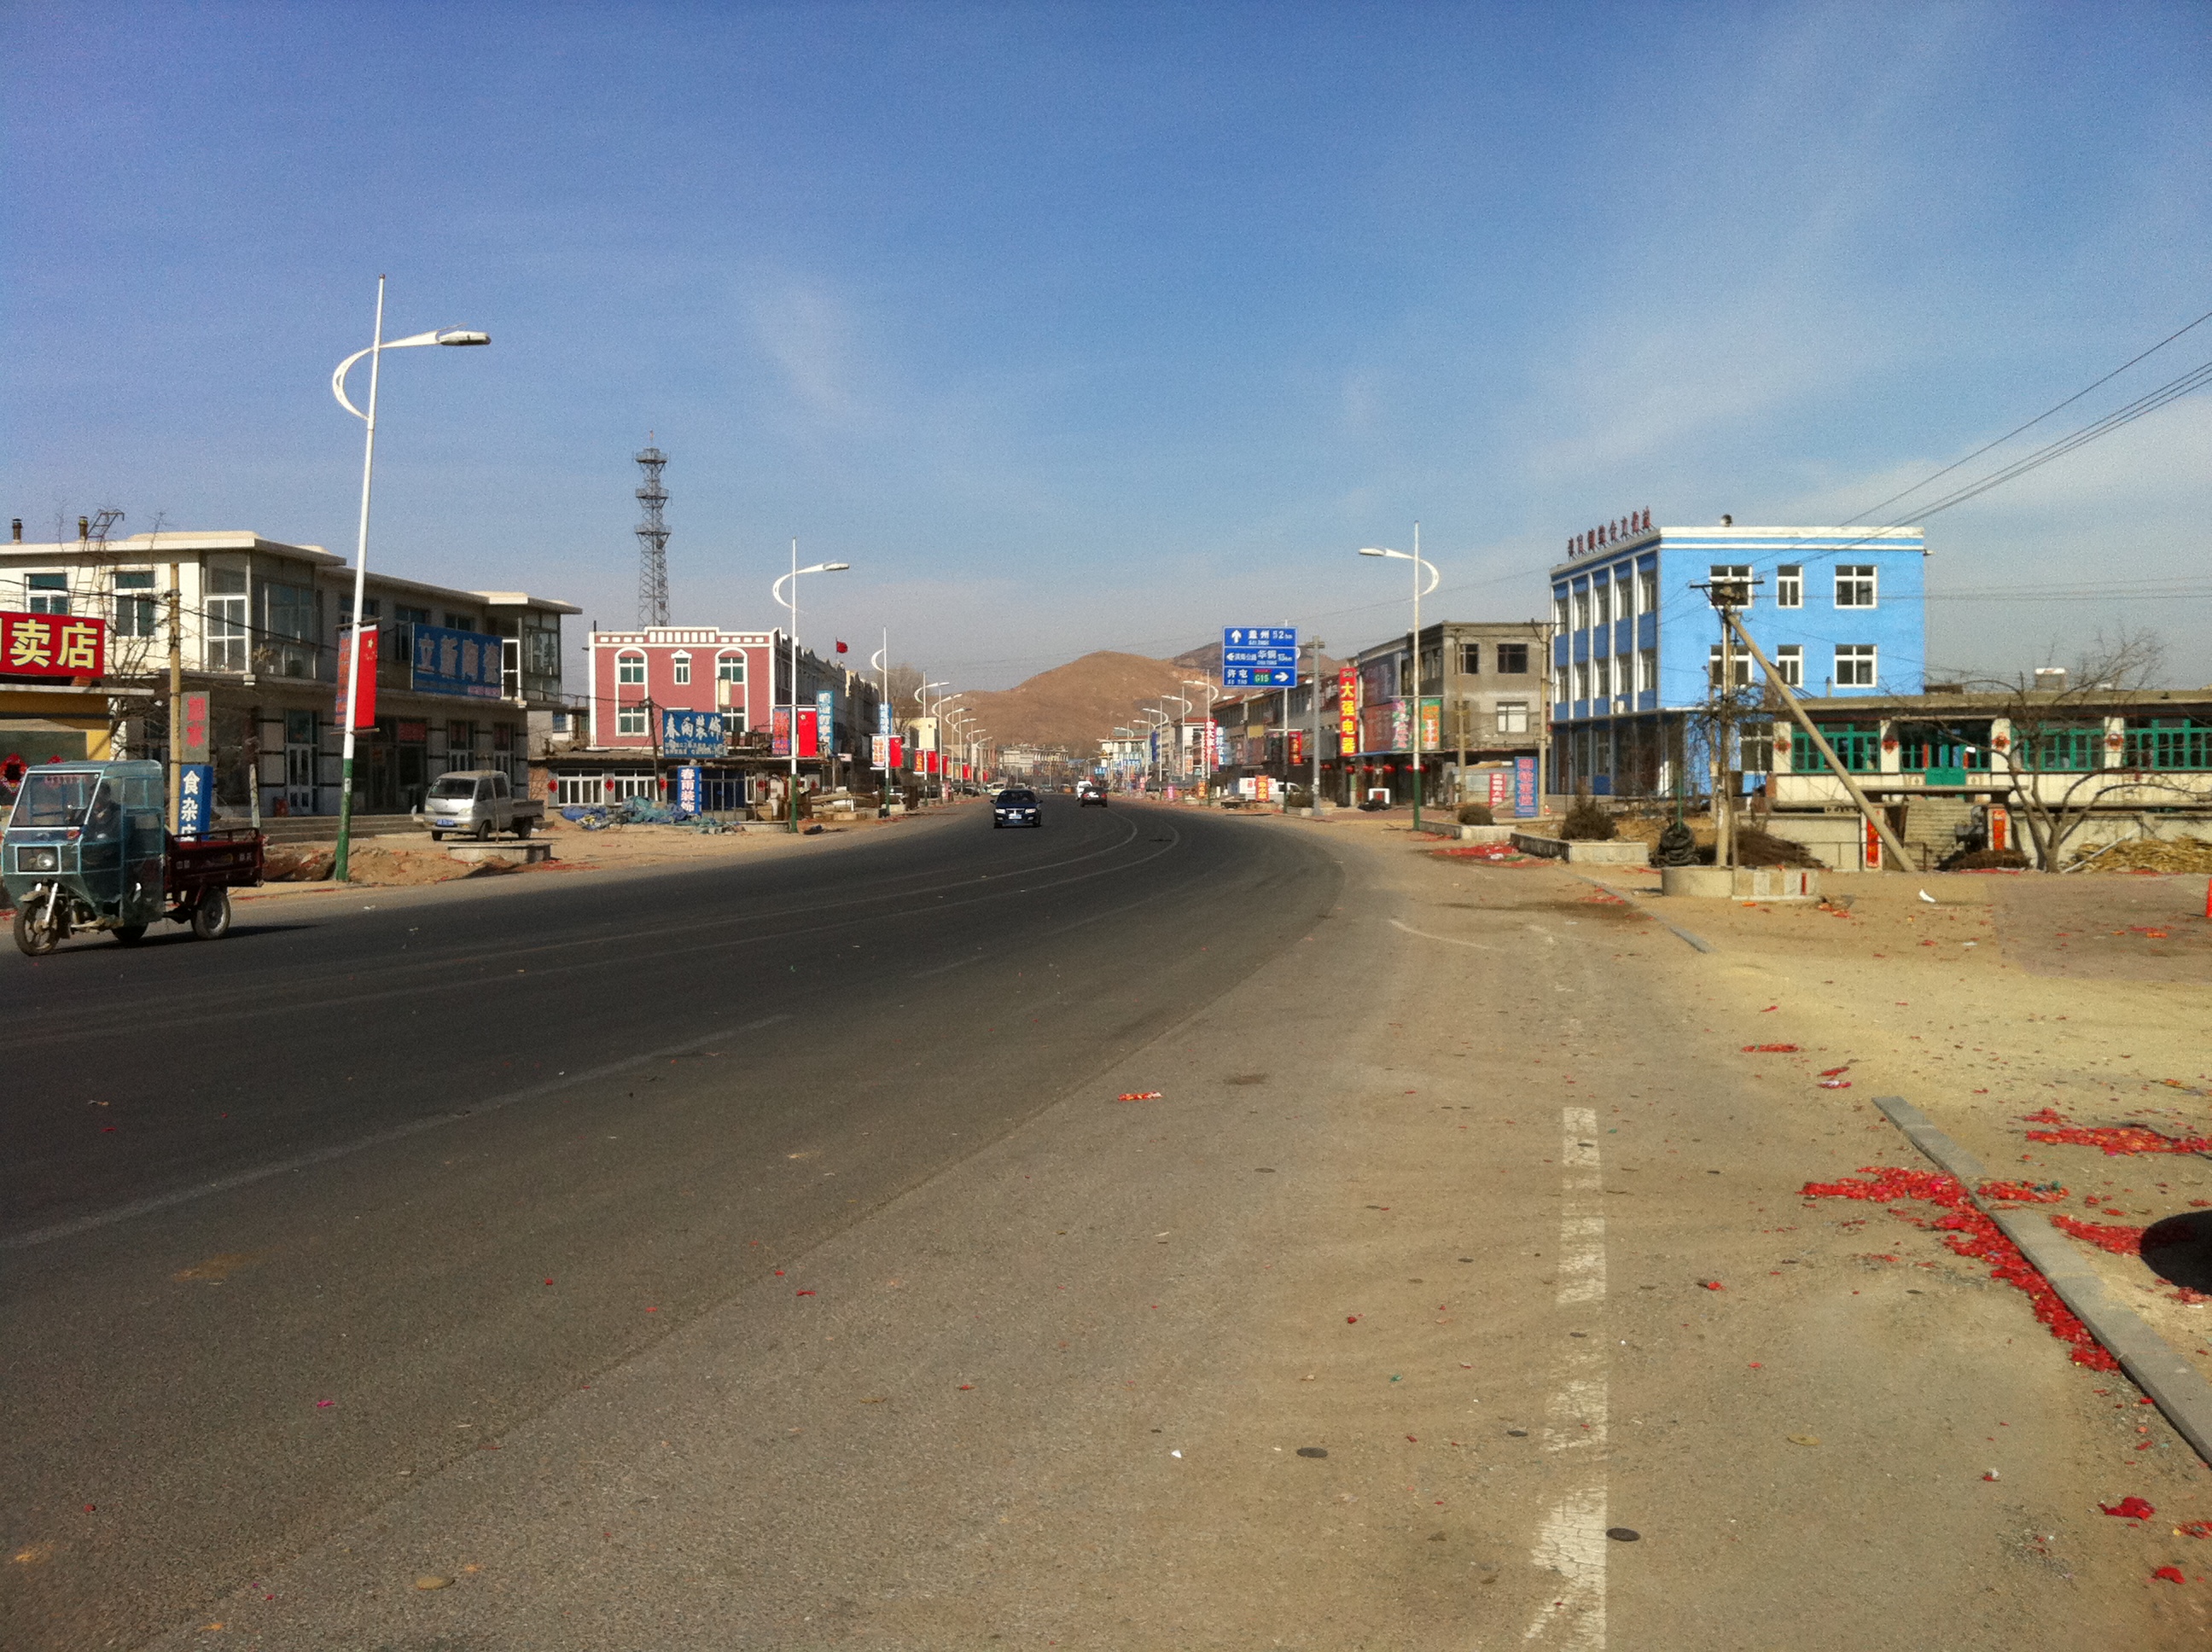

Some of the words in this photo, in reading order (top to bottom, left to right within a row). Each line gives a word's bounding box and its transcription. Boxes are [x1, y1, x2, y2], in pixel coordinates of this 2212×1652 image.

[0, 618, 98, 669] 卖店
[664, 713, 722, 741] 春雨装饰
[1341, 681, 1356, 753] 大强电器
[180, 771, 201, 842] 食杂店
[681, 768, 696, 812] 春雨装饰
